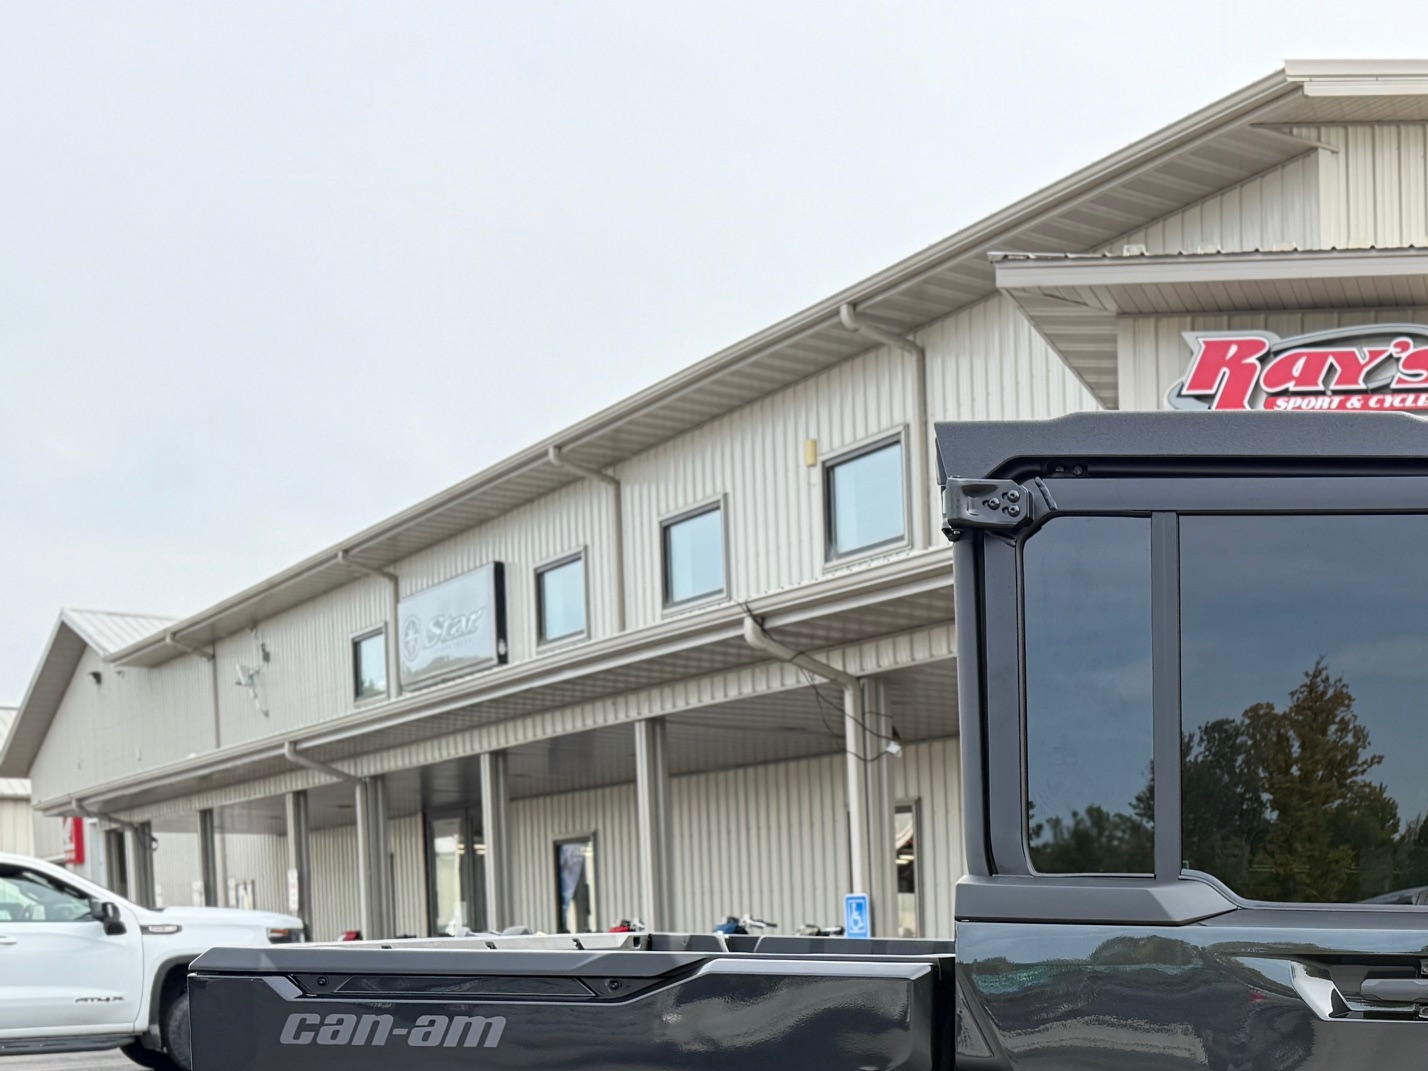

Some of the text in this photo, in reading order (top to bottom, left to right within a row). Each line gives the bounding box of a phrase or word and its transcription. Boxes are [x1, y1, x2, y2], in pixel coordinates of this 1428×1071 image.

[1274, 395, 1339, 411] SPORT
[1346, 395, 1365, 409] &
[279, 1012, 507, 1048] can-am
